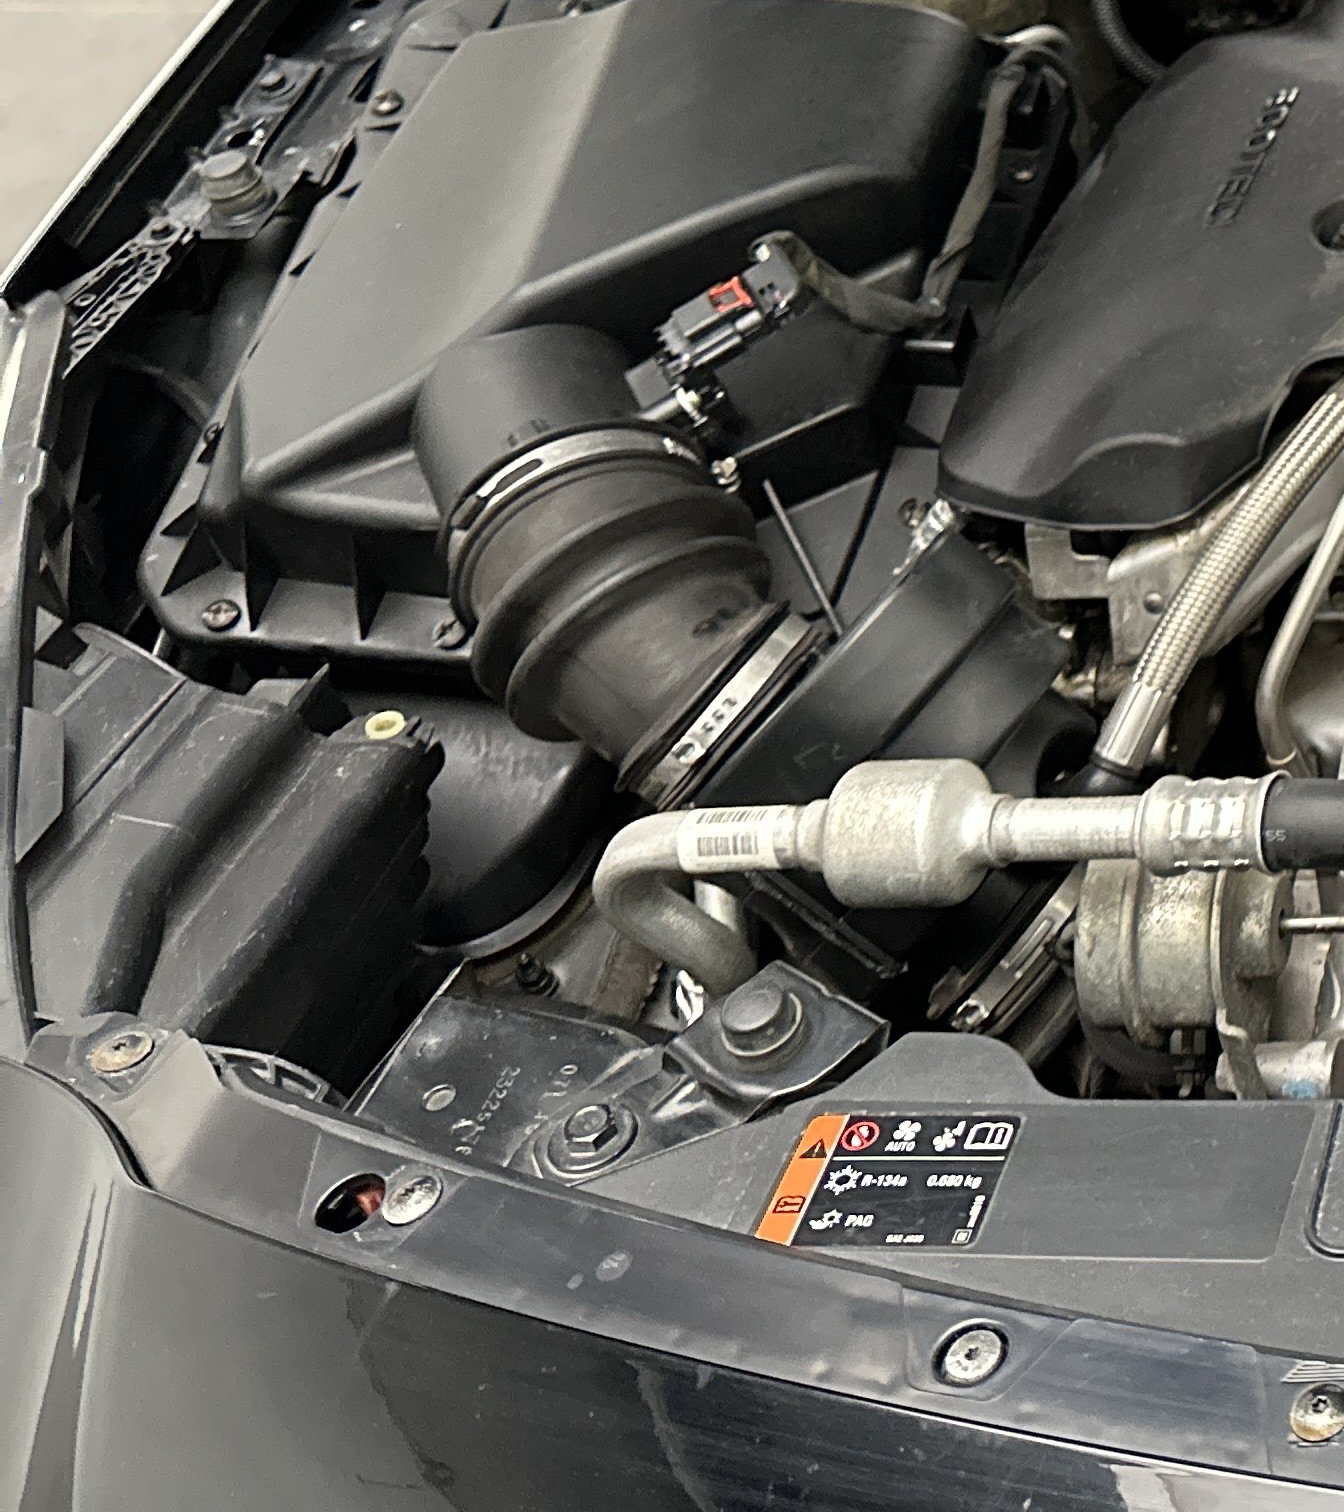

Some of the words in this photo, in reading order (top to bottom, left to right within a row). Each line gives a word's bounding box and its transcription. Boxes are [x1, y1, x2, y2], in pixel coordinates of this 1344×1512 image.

[1203, 85, 1301, 229] ECOTEC
[884, 1140, 917, 1152] AUTO
[860, 1173, 910, 1188] R-134a
[843, 1213, 875, 1228] PAG
